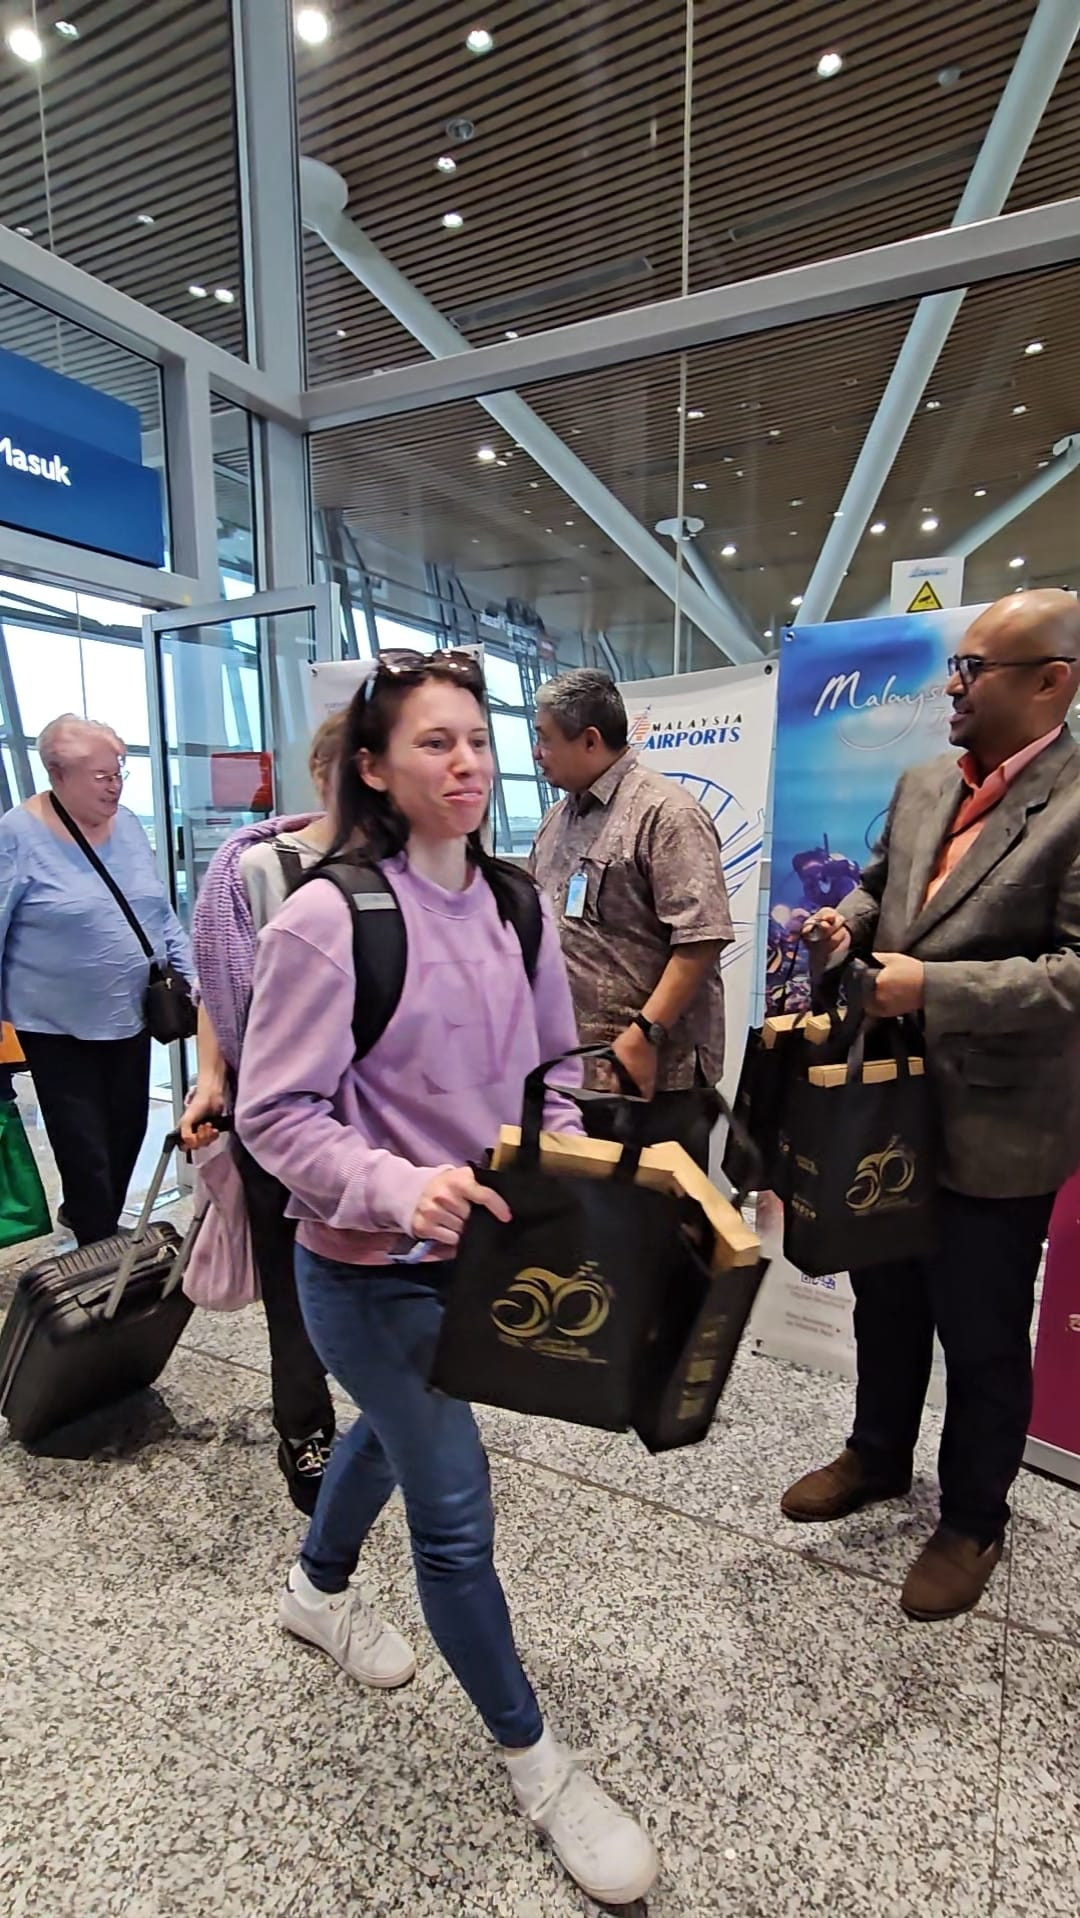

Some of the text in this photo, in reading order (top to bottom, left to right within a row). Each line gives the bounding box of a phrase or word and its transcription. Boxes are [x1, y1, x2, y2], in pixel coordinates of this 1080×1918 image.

[652, 713, 743, 732] MALAYSIA
[813, 671, 948, 750] Malays
[642, 726, 742, 750] AIRPORTS
